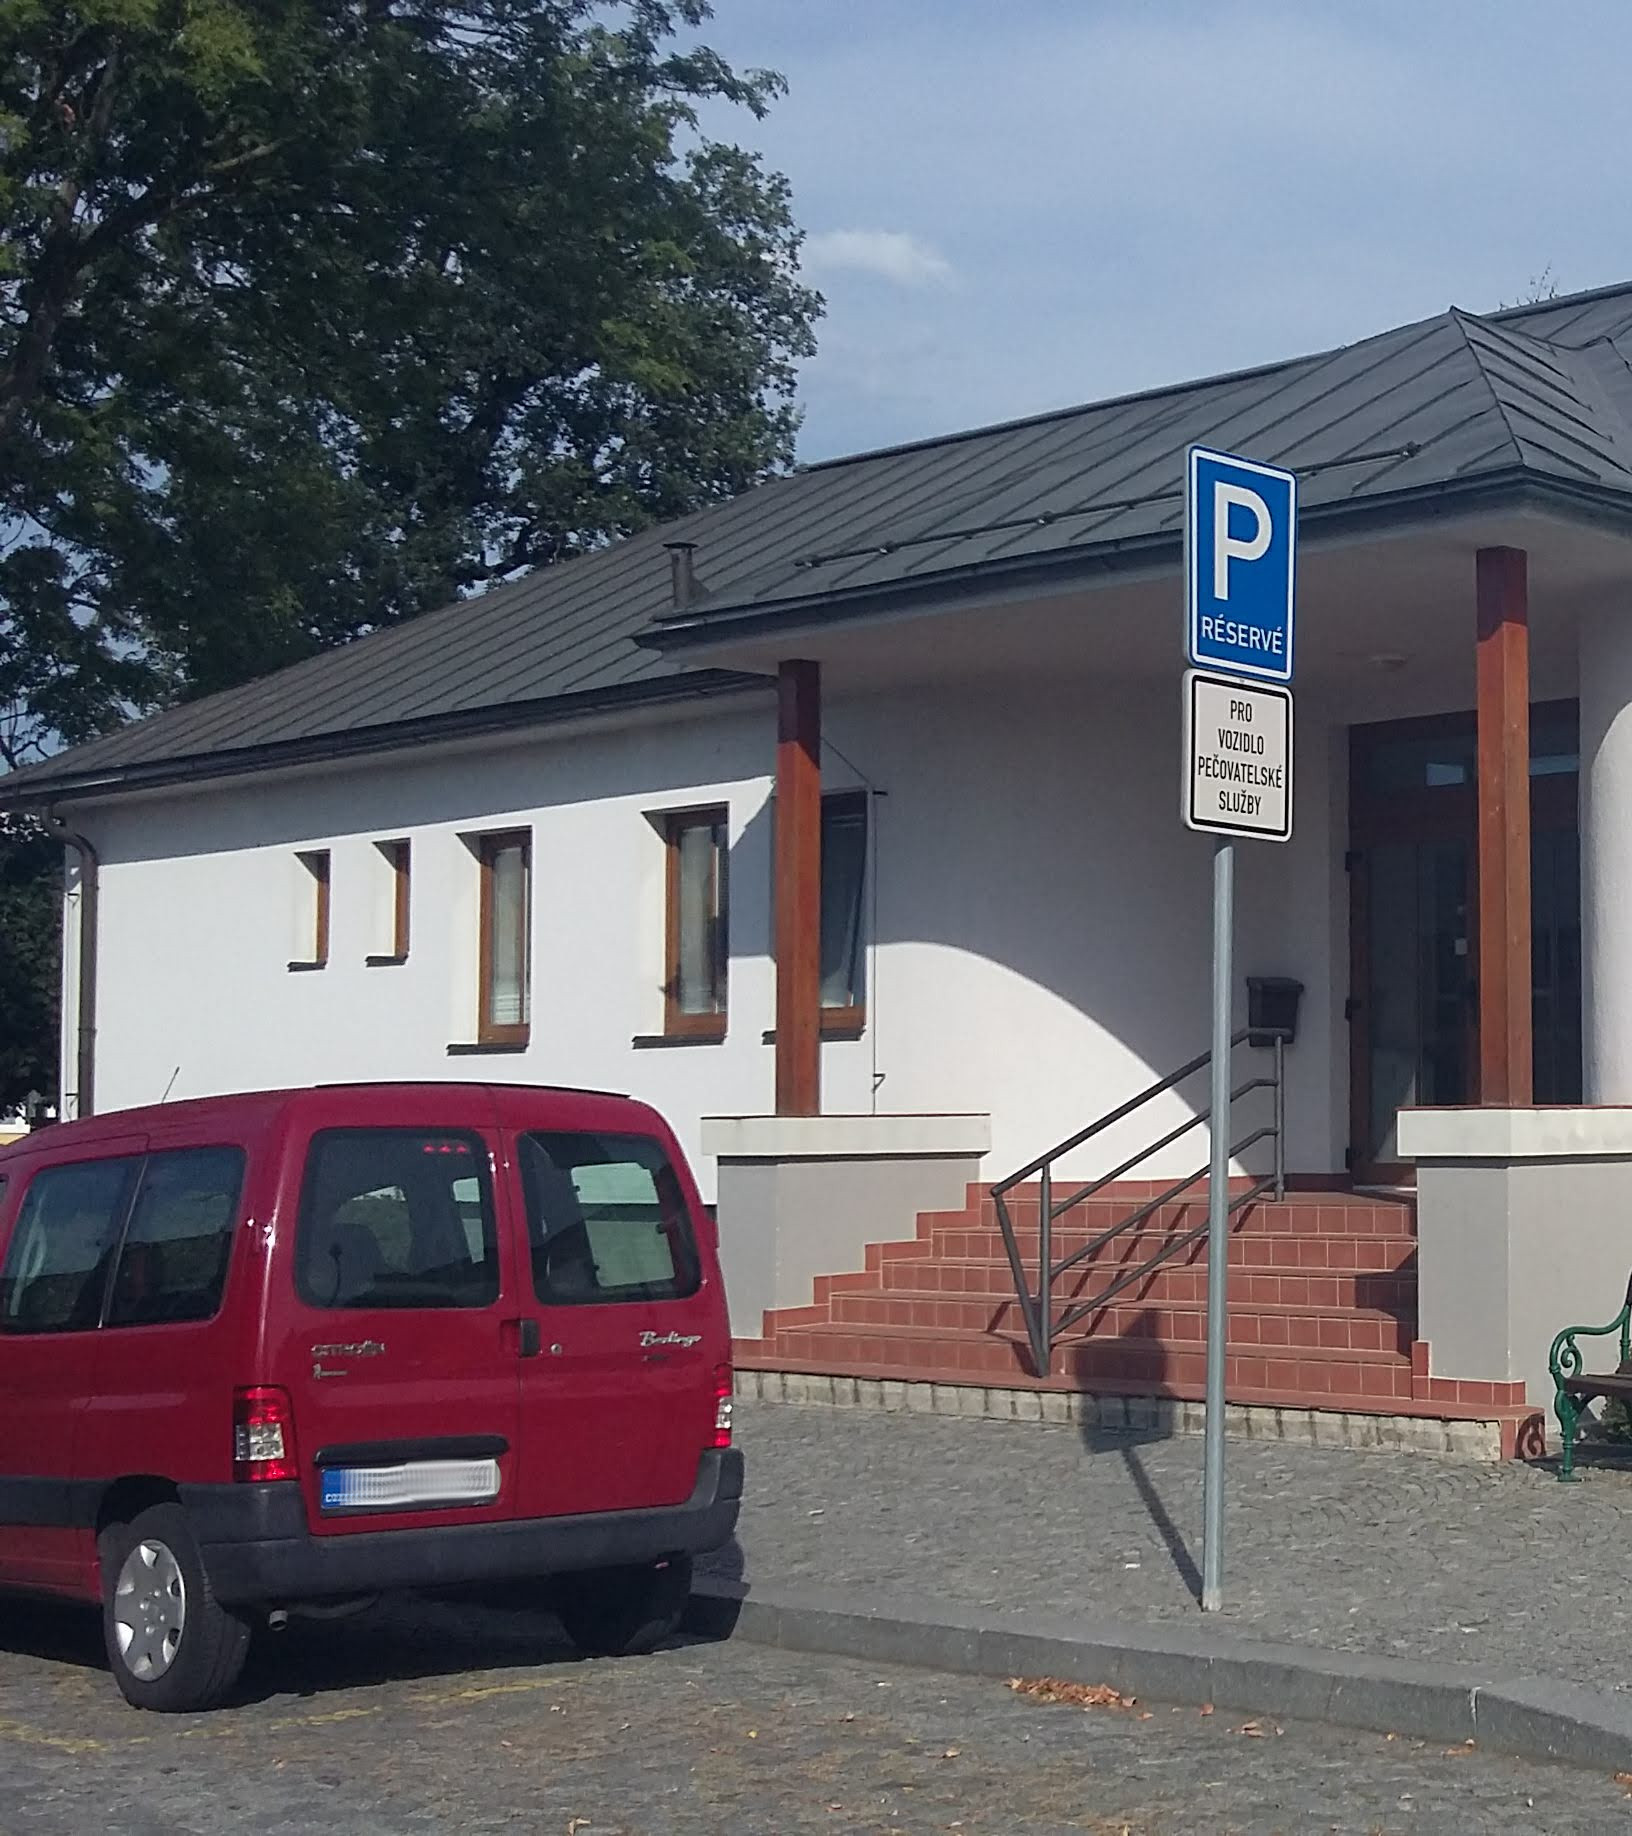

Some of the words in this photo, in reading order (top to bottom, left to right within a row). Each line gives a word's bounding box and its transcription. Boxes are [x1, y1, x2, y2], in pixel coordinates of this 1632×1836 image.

[1214, 480, 1272, 600] P
[1202, 613, 1283, 655] RÉSERVÉ
[1230, 700, 1253, 722] PRO
[1218, 728, 1264, 755] VOZIDLO
[1198, 754, 1282, 788] PEČOVATELSKÉ
[1219, 789, 1261, 816] SLUŽBY
